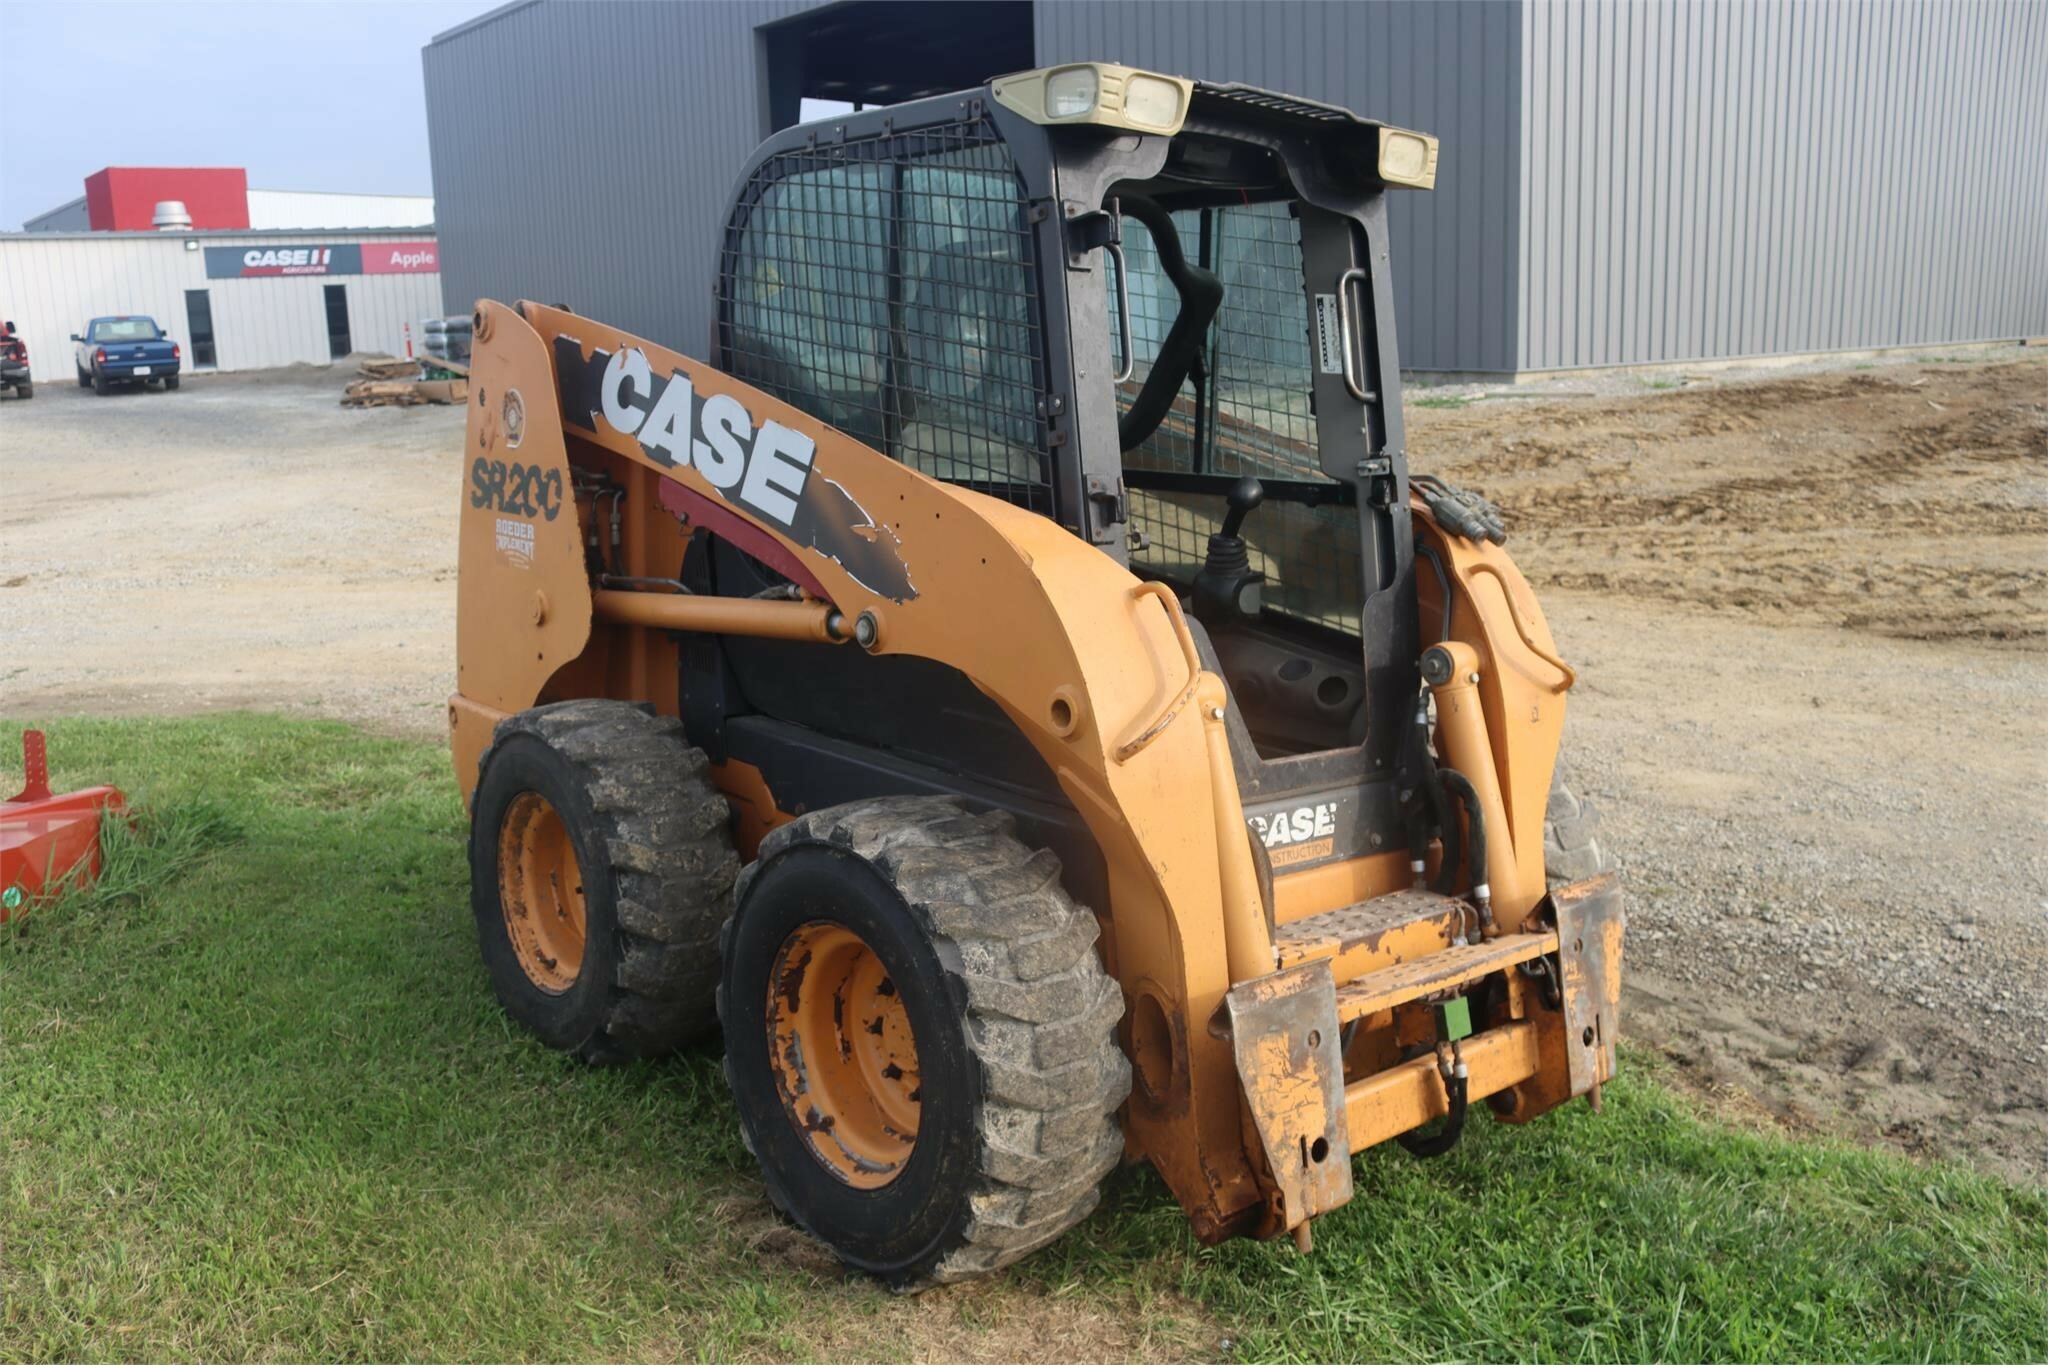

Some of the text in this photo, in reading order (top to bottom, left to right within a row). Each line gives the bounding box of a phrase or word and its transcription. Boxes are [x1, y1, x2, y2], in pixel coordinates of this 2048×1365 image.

[243, 249, 309, 267] CASE
[390, 251, 434, 267] Apple
[601, 347, 816, 526] CASE
[471, 456, 563, 521] SR200
[495, 518, 535, 540] ROEDER
[1270, 842, 1331, 865] NSTRUCTION
